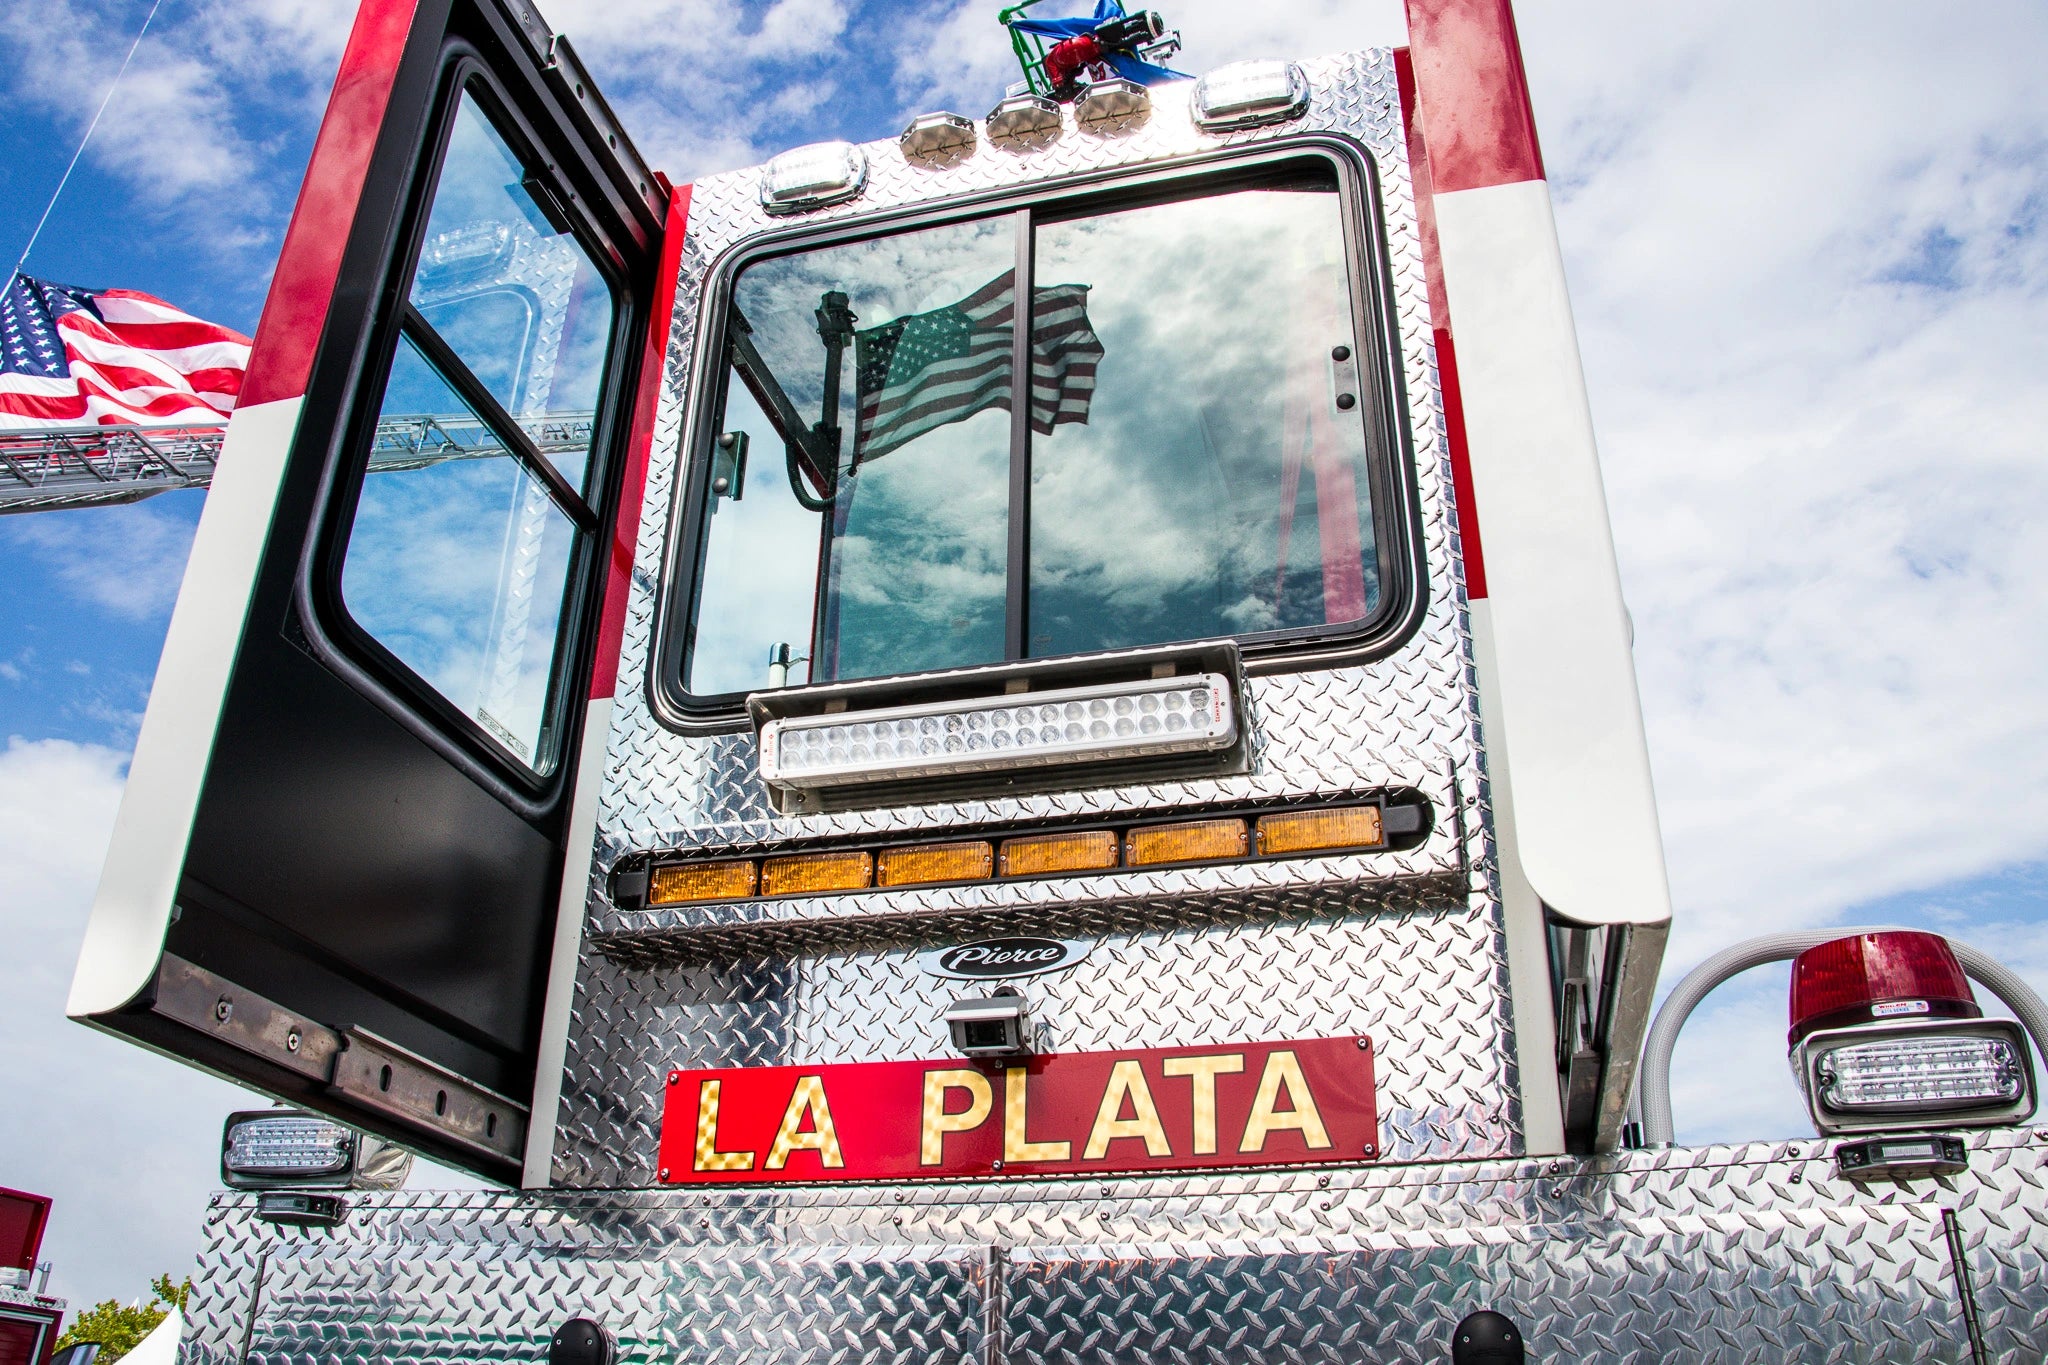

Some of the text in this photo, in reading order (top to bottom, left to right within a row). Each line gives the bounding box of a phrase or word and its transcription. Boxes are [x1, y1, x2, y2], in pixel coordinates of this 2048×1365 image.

[948, 946, 1060, 970] Pierce
[693, 1049, 1334, 1171] LA PLATA
